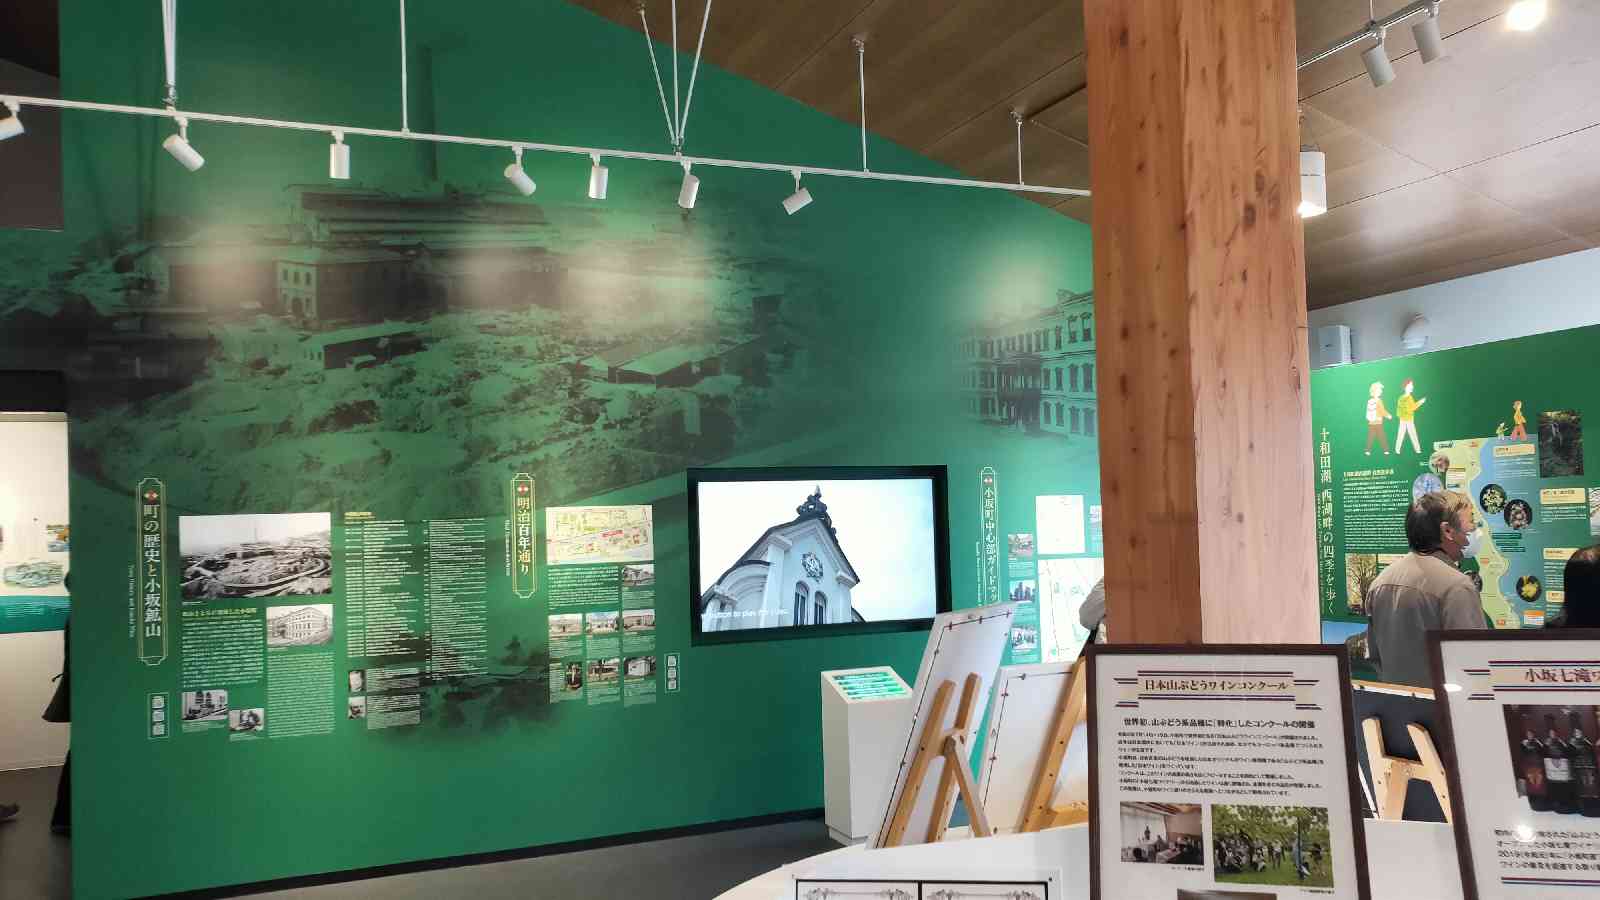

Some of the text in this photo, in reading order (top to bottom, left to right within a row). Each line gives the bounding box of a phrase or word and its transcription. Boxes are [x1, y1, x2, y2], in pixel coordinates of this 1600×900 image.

[143, 504, 162, 637] 町の歴史と小坂鉱山
[517, 497, 531, 576] 明治百年通り
[1144, 678, 1289, 692] 日本山ぶどうワインコンクール
